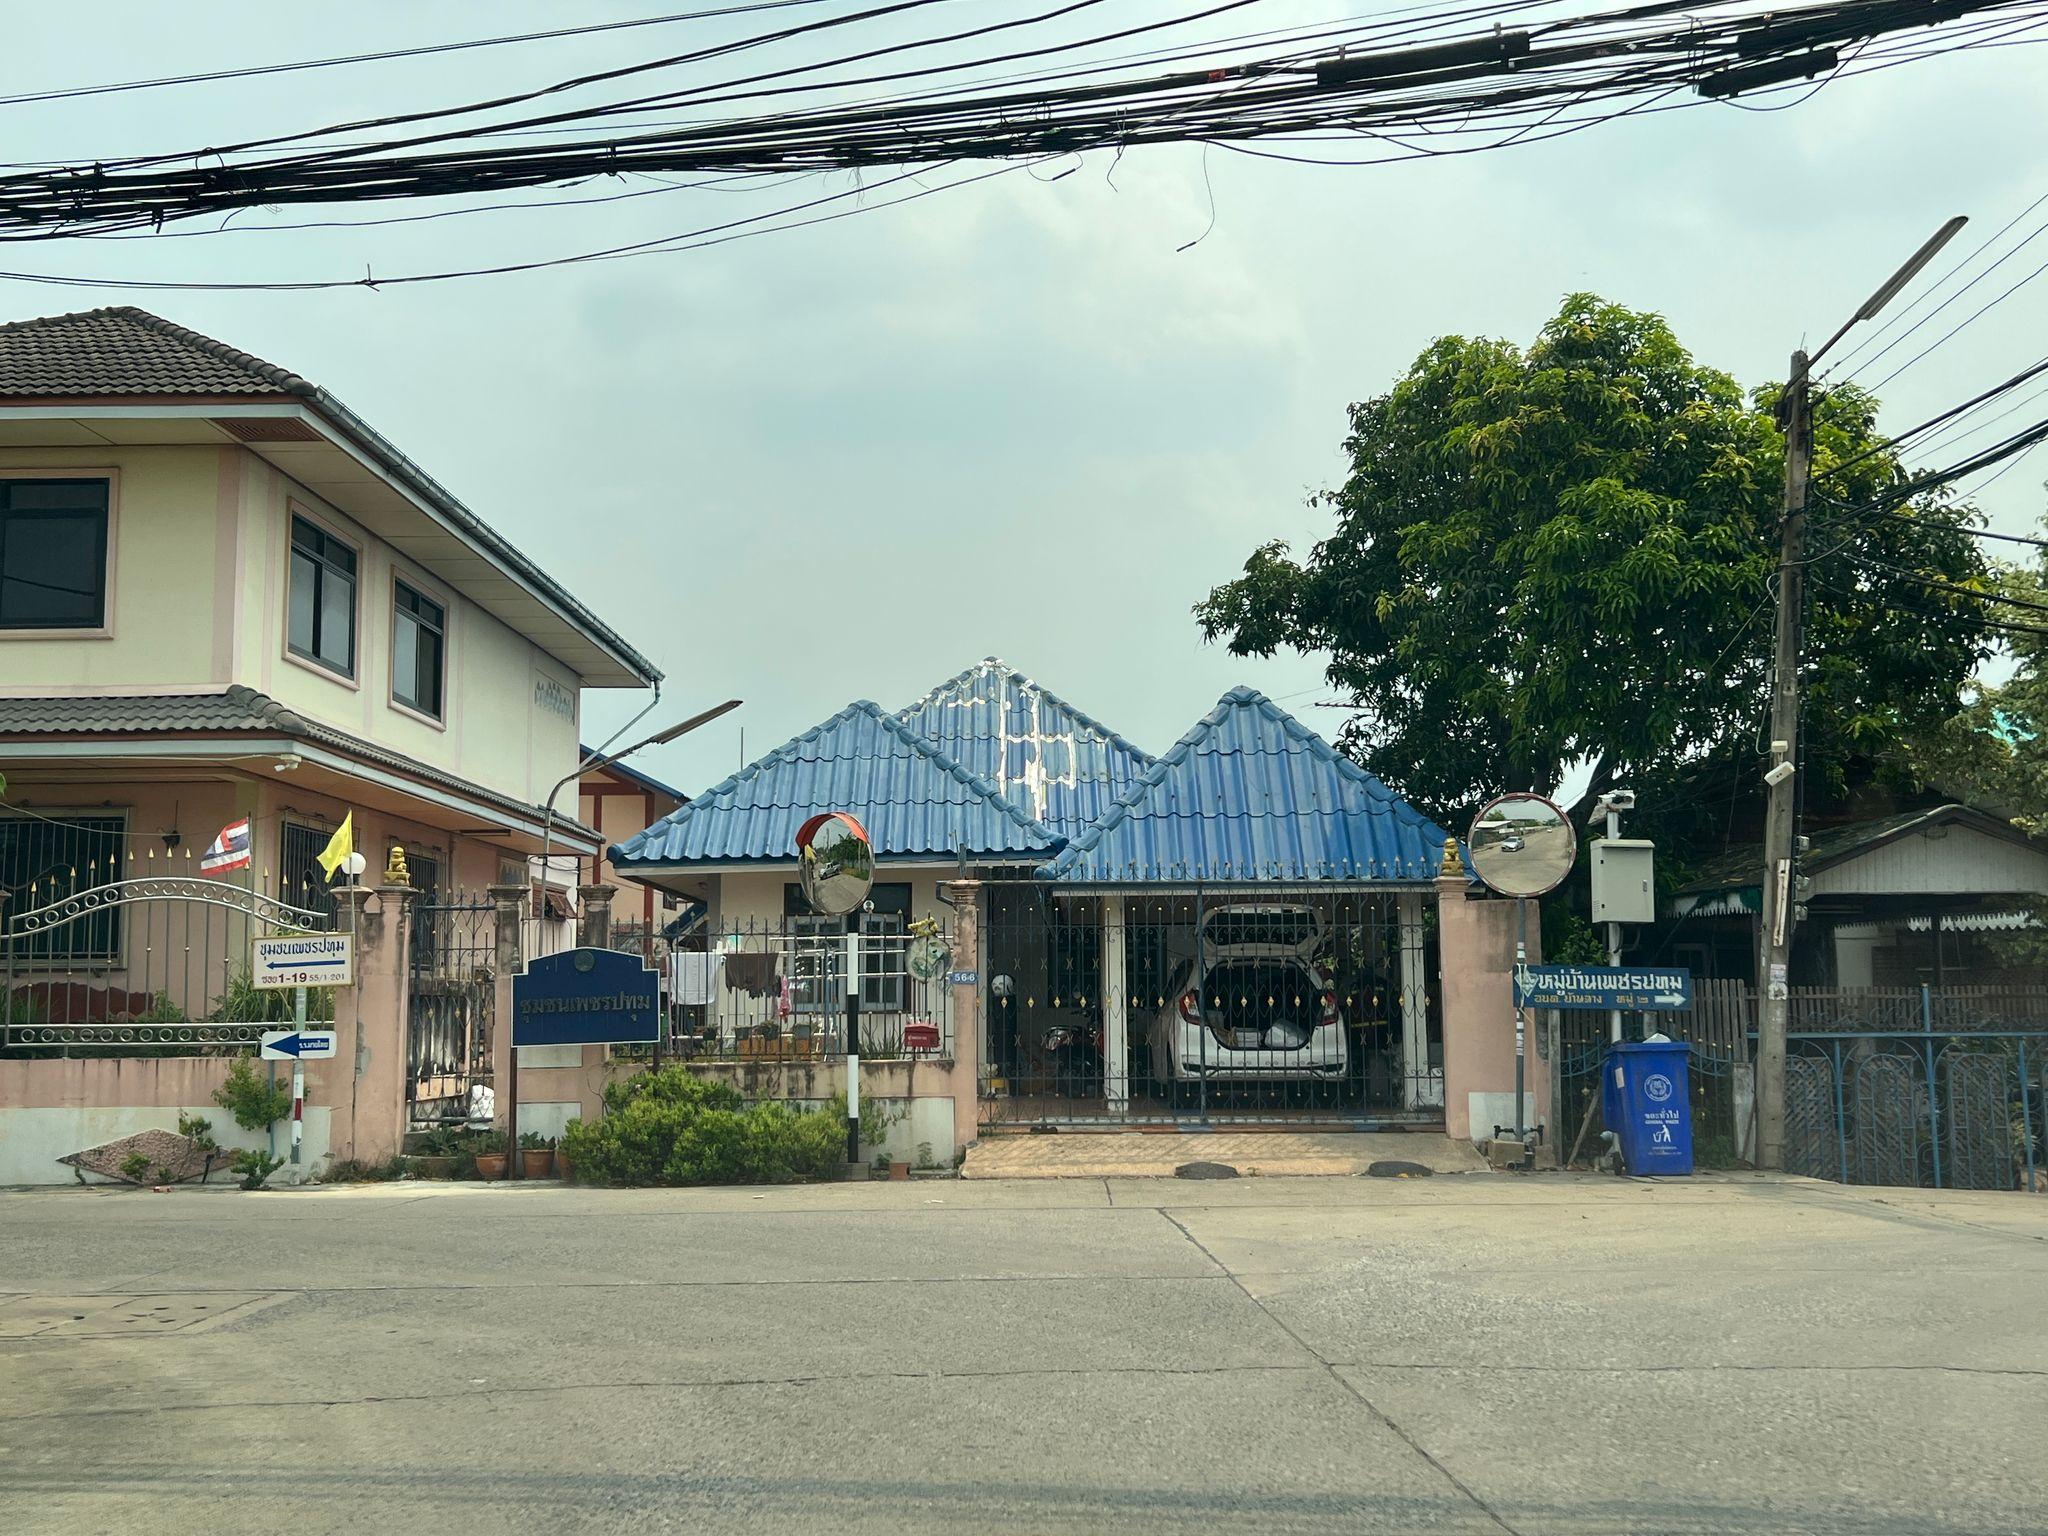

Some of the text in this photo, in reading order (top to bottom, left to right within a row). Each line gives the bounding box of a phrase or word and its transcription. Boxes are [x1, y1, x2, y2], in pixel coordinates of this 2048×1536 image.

[260, 938, 345, 961] ชุมชนเพชรปทุม
[279, 972, 307, 983] 1-19
[1538, 969, 1682, 996] หมู่บ้านเพชรปทุม
[520, 991, 650, 1023] ชุมชนเพชรปทุม
